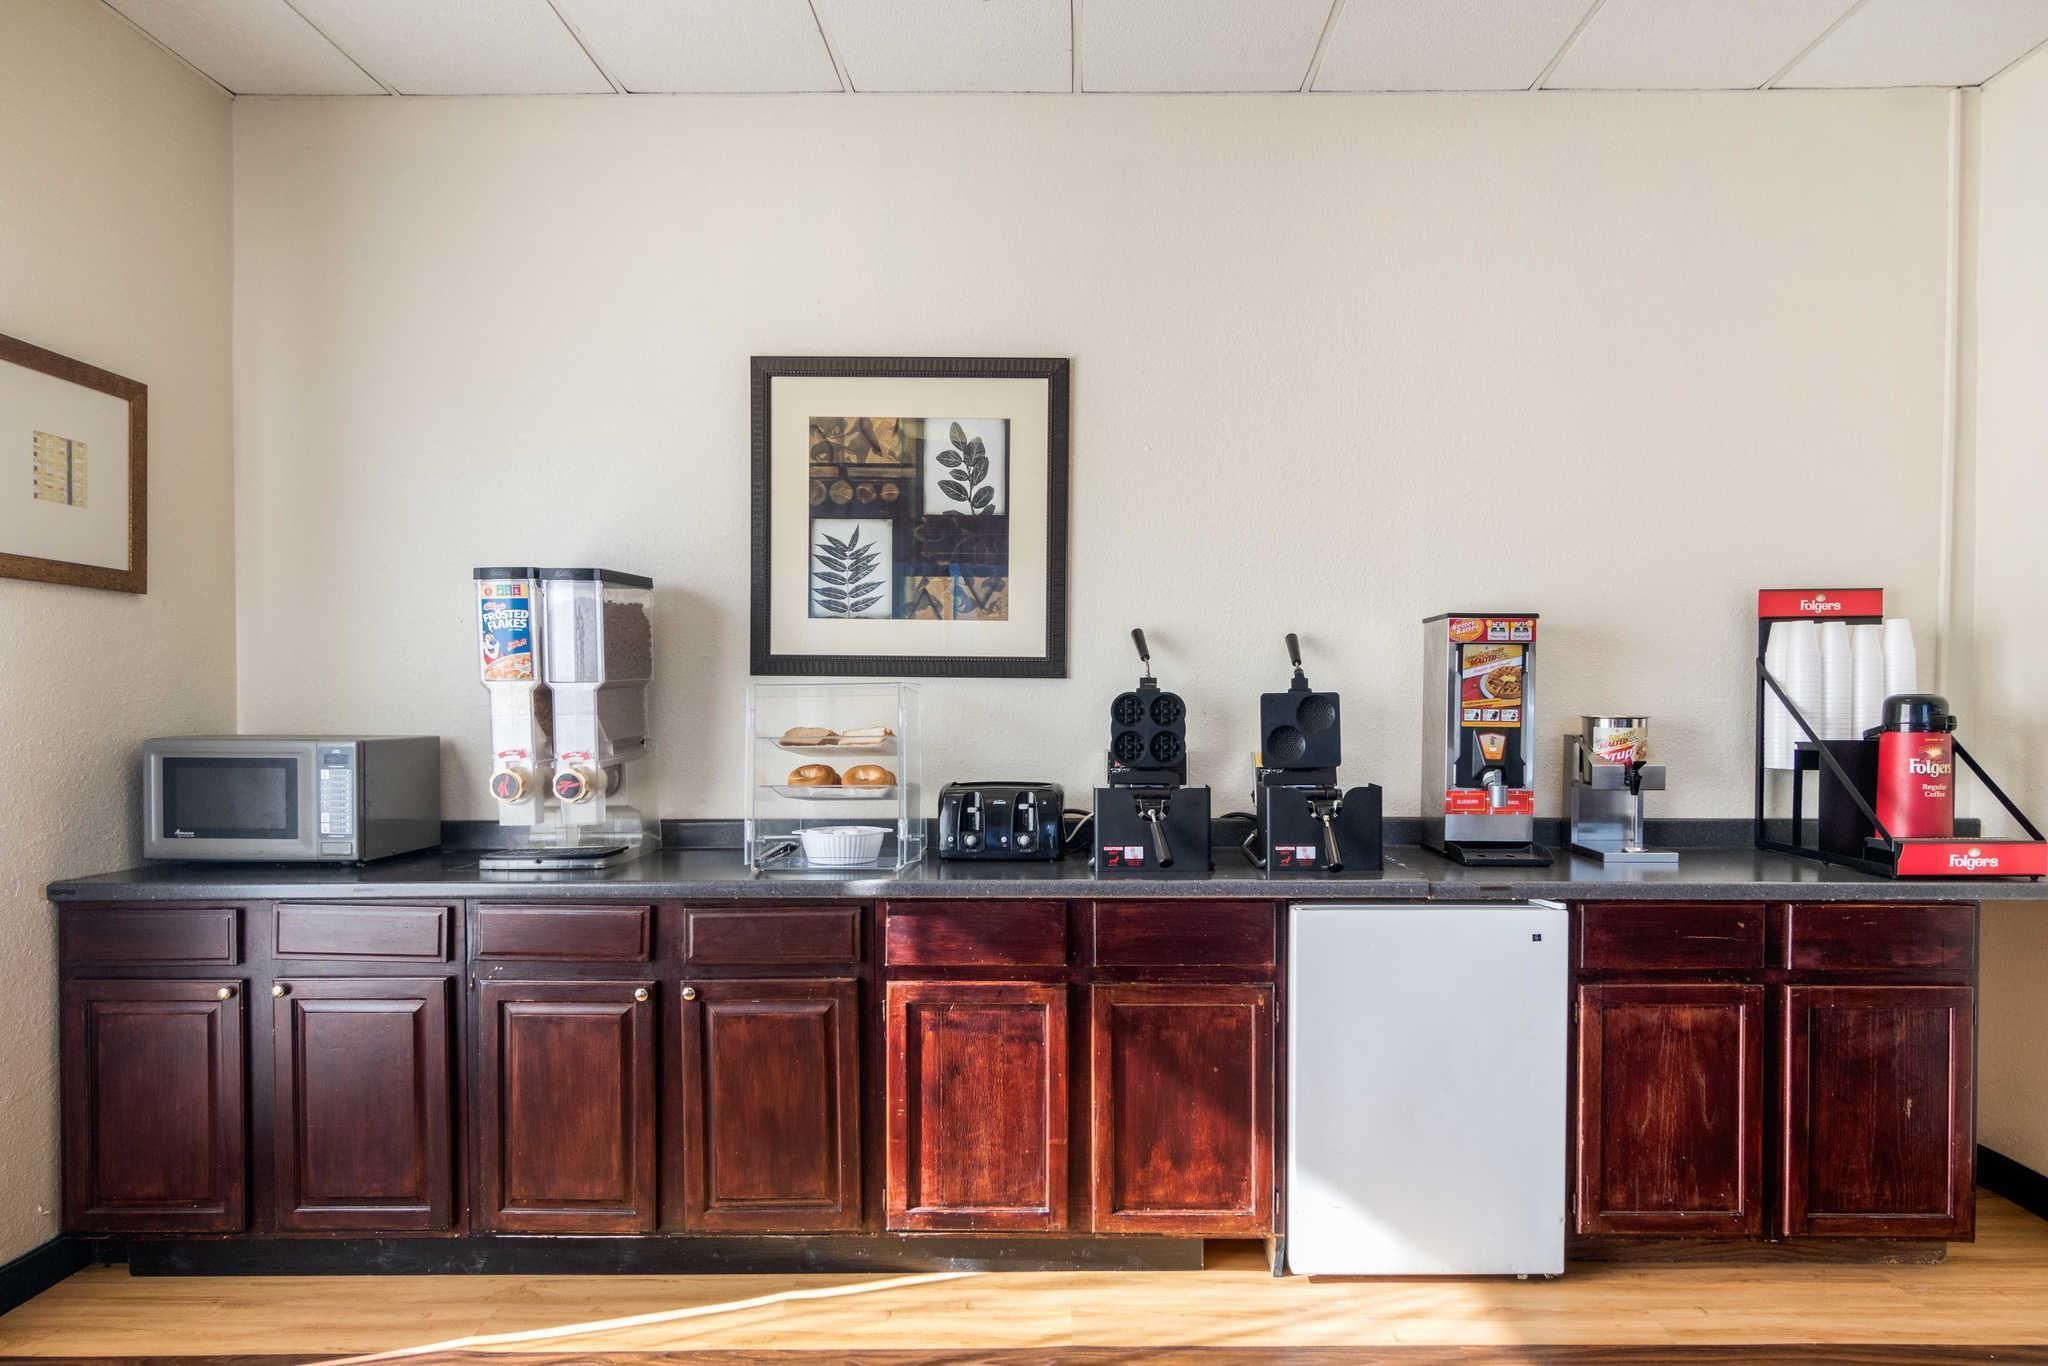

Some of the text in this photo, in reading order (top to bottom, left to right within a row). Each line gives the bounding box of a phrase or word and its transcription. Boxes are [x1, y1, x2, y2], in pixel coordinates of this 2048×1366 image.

[1800, 599, 1841, 613] Folgers
[483, 609, 528, 622] FROSTED
[487, 618, 527, 632] FLAKES
[1949, 854, 1999, 870] Folgers
